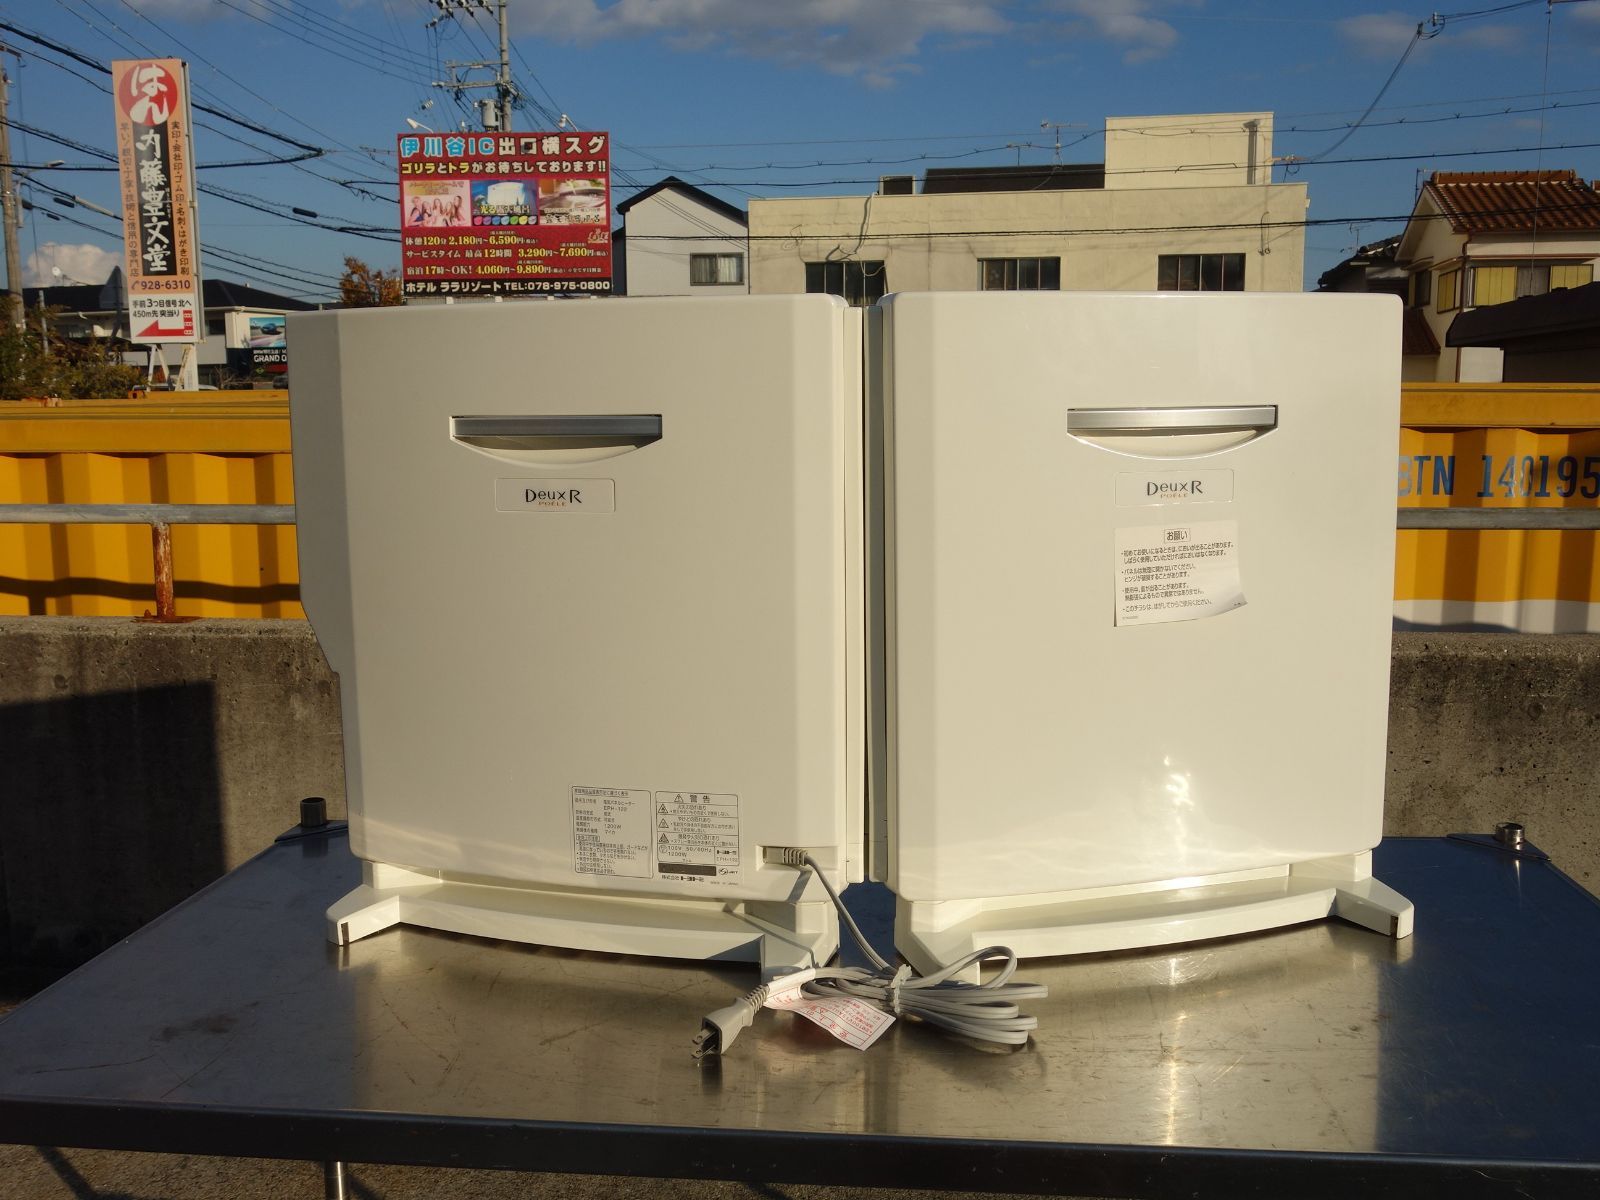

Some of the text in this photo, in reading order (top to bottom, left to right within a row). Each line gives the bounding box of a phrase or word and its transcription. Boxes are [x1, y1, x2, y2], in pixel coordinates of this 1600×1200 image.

[129, 64, 168, 126] はん
[400, 136, 606, 158] 伊川谷IC出口横スグ
[401, 161, 606, 174] ゴリラとトラがお待ちしております!!
[406, 249, 461, 258] サービスタイム
[141, 280, 191, 290] 928-6310
[406, 281, 610, 293] ホテル ララリゾート TEL:078-975-0800
[133, 310, 159, 318] 450m先
[253, 354, 280, 362] GRAND
[1166, 530, 1188, 541] お願い
